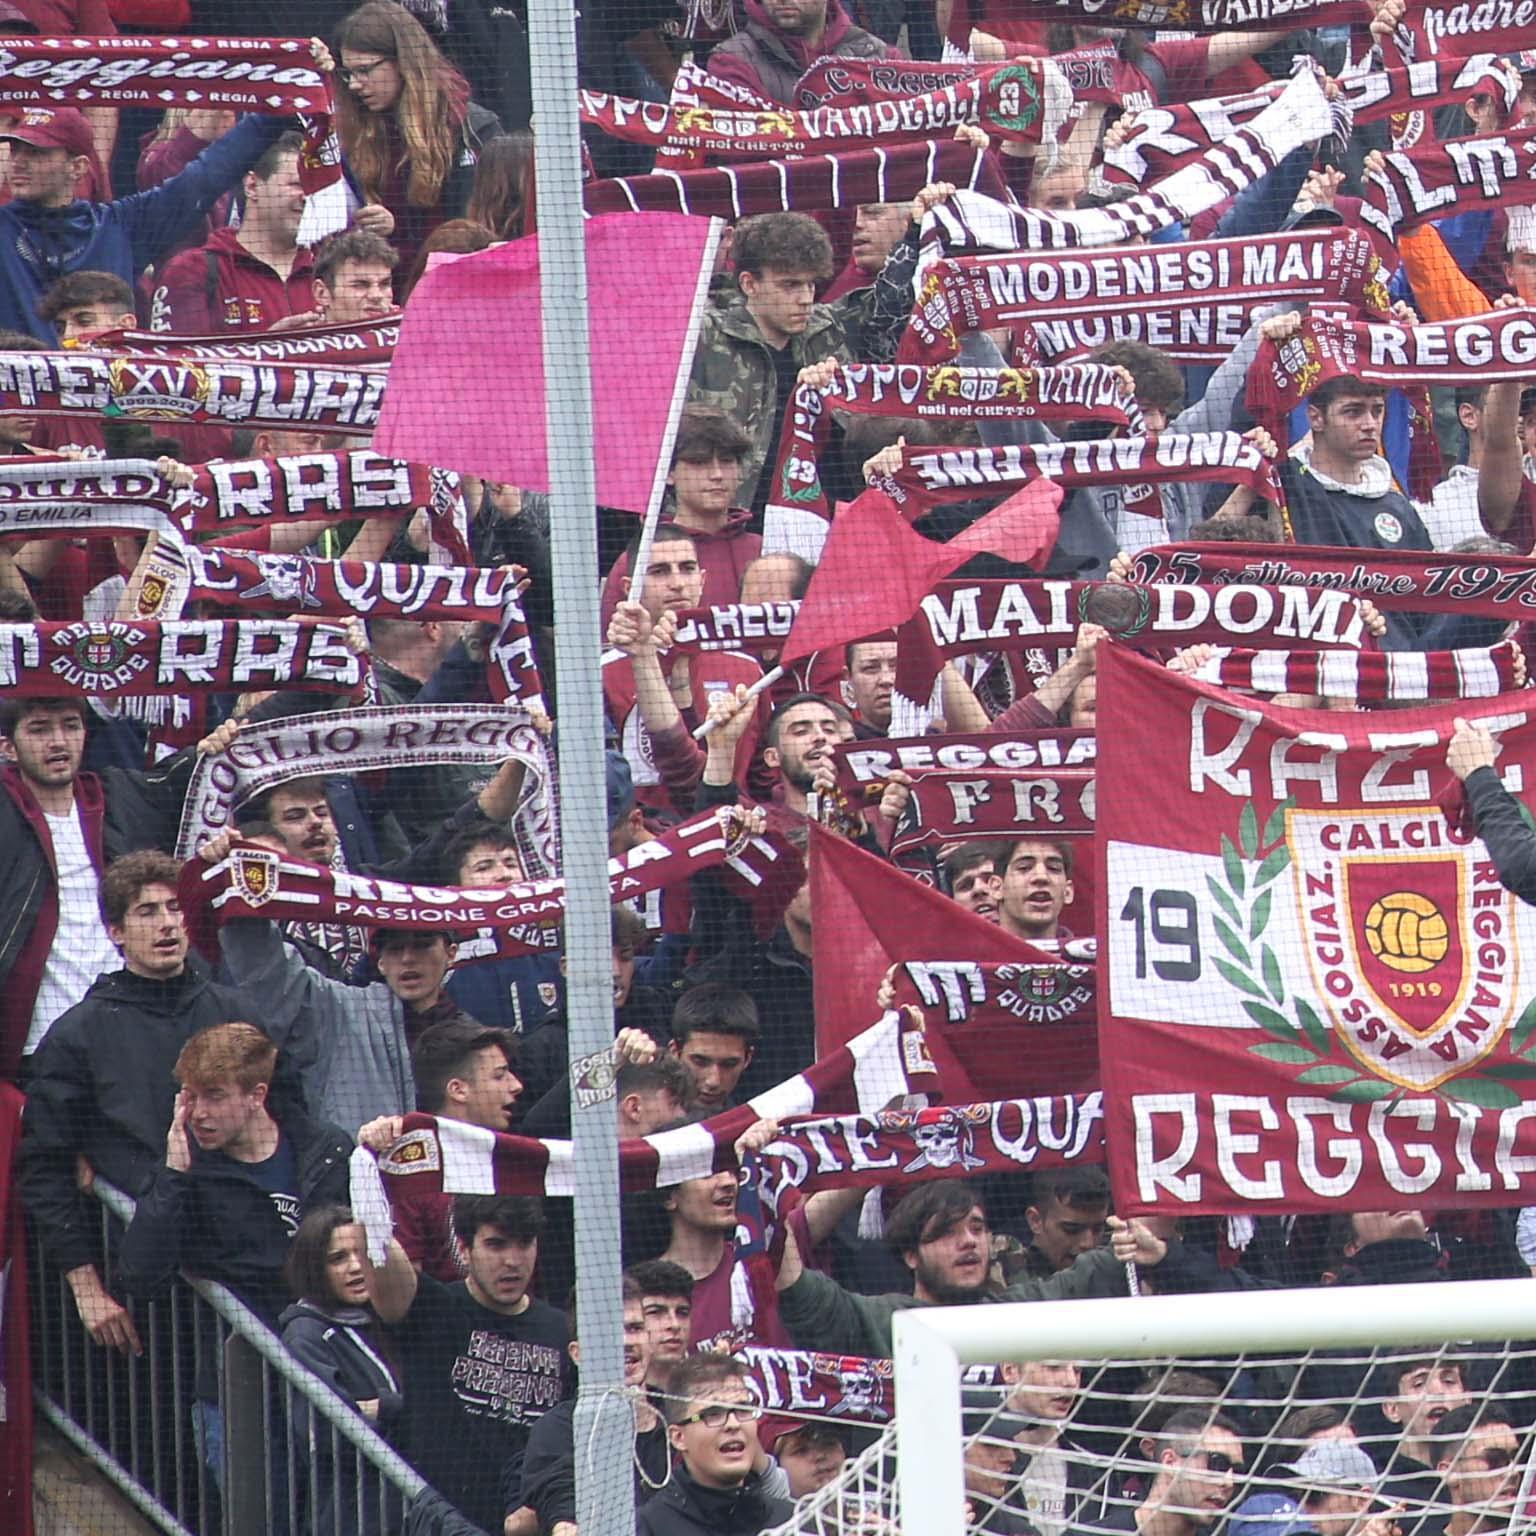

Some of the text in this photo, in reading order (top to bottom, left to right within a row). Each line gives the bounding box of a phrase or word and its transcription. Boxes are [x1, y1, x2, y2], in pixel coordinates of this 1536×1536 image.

[0, 49, 325, 90] eggiana
[984, 249, 1231, 309] MODENESI
[1240, 240, 1325, 284] MAI
[920, 581, 1074, 646] MAI
[845, 736, 1097, 780] REGGIA
[335, 900, 486, 924] PASSIONE
[1119, 885, 1201, 983] 19
[1387, 981, 1443, 1000] 1919
